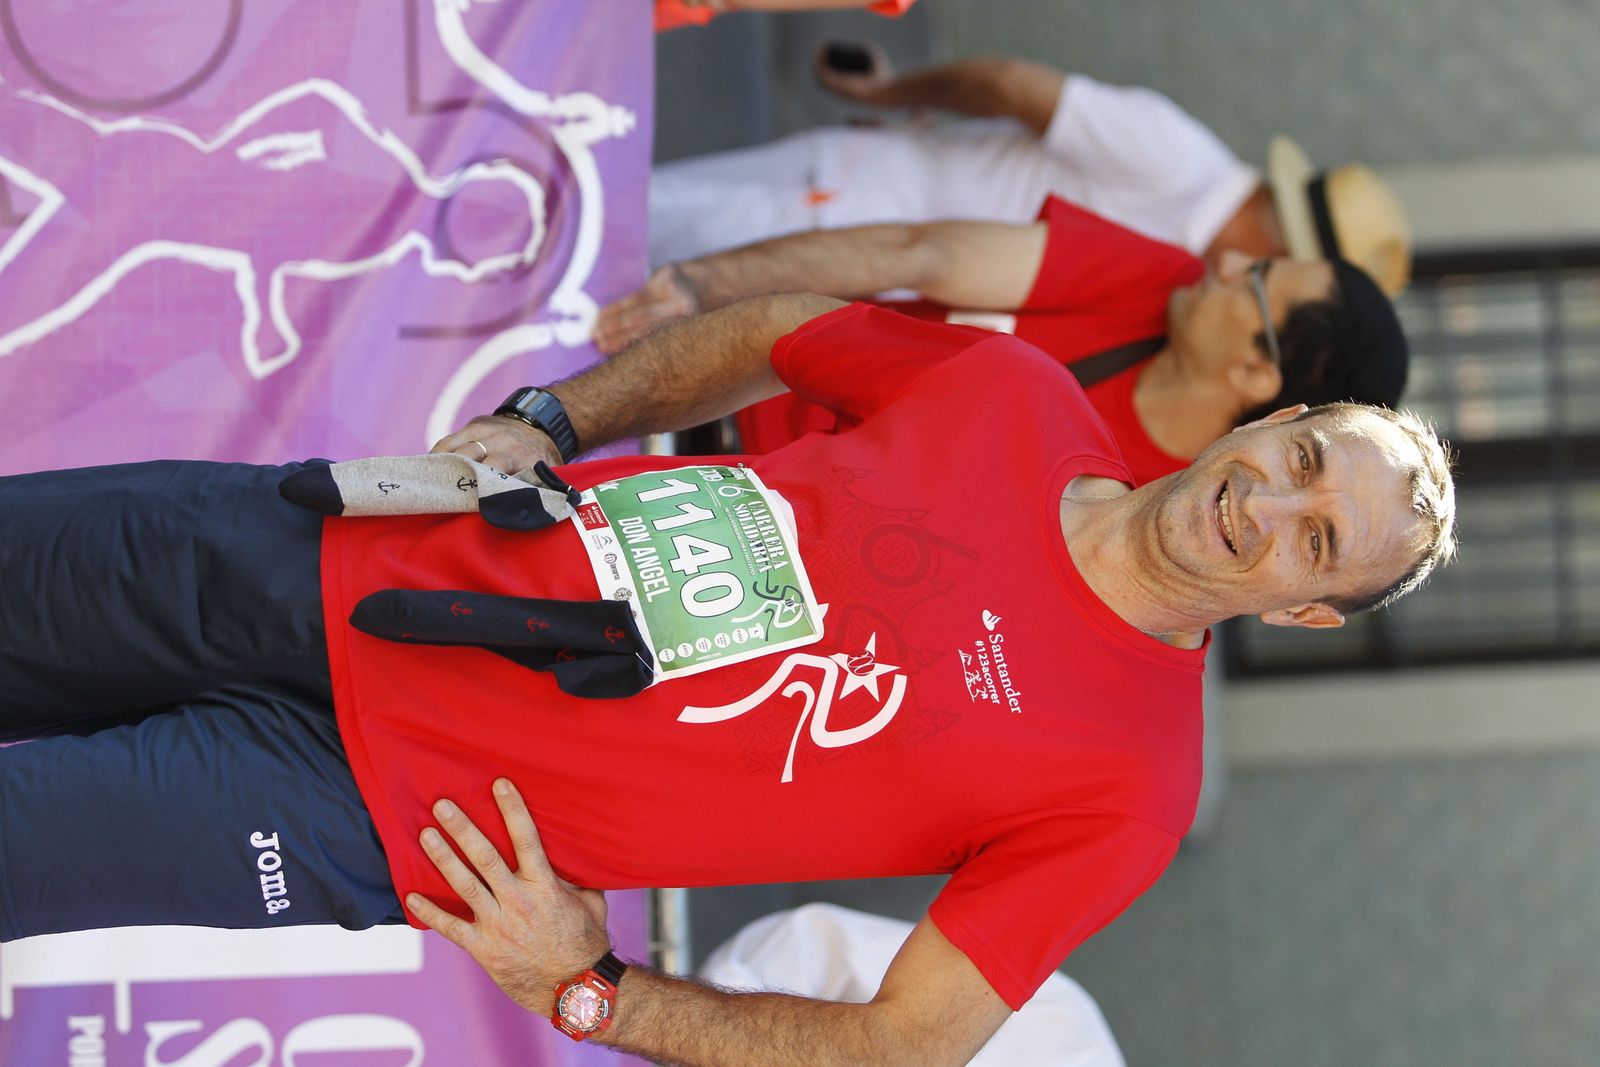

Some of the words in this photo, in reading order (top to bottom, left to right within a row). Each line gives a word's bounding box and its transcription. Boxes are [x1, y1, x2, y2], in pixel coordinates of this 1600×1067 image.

[617, 516, 650, 544] DON
[636, 478, 745, 618] 1140
[732, 503, 772, 573] SOLIDARIA
[747, 501, 789, 570] CARRERA
[631, 545, 671, 603] ANGEL
[974, 639, 1001, 705] #123acorrer
[989, 633, 1022, 714] Santander
